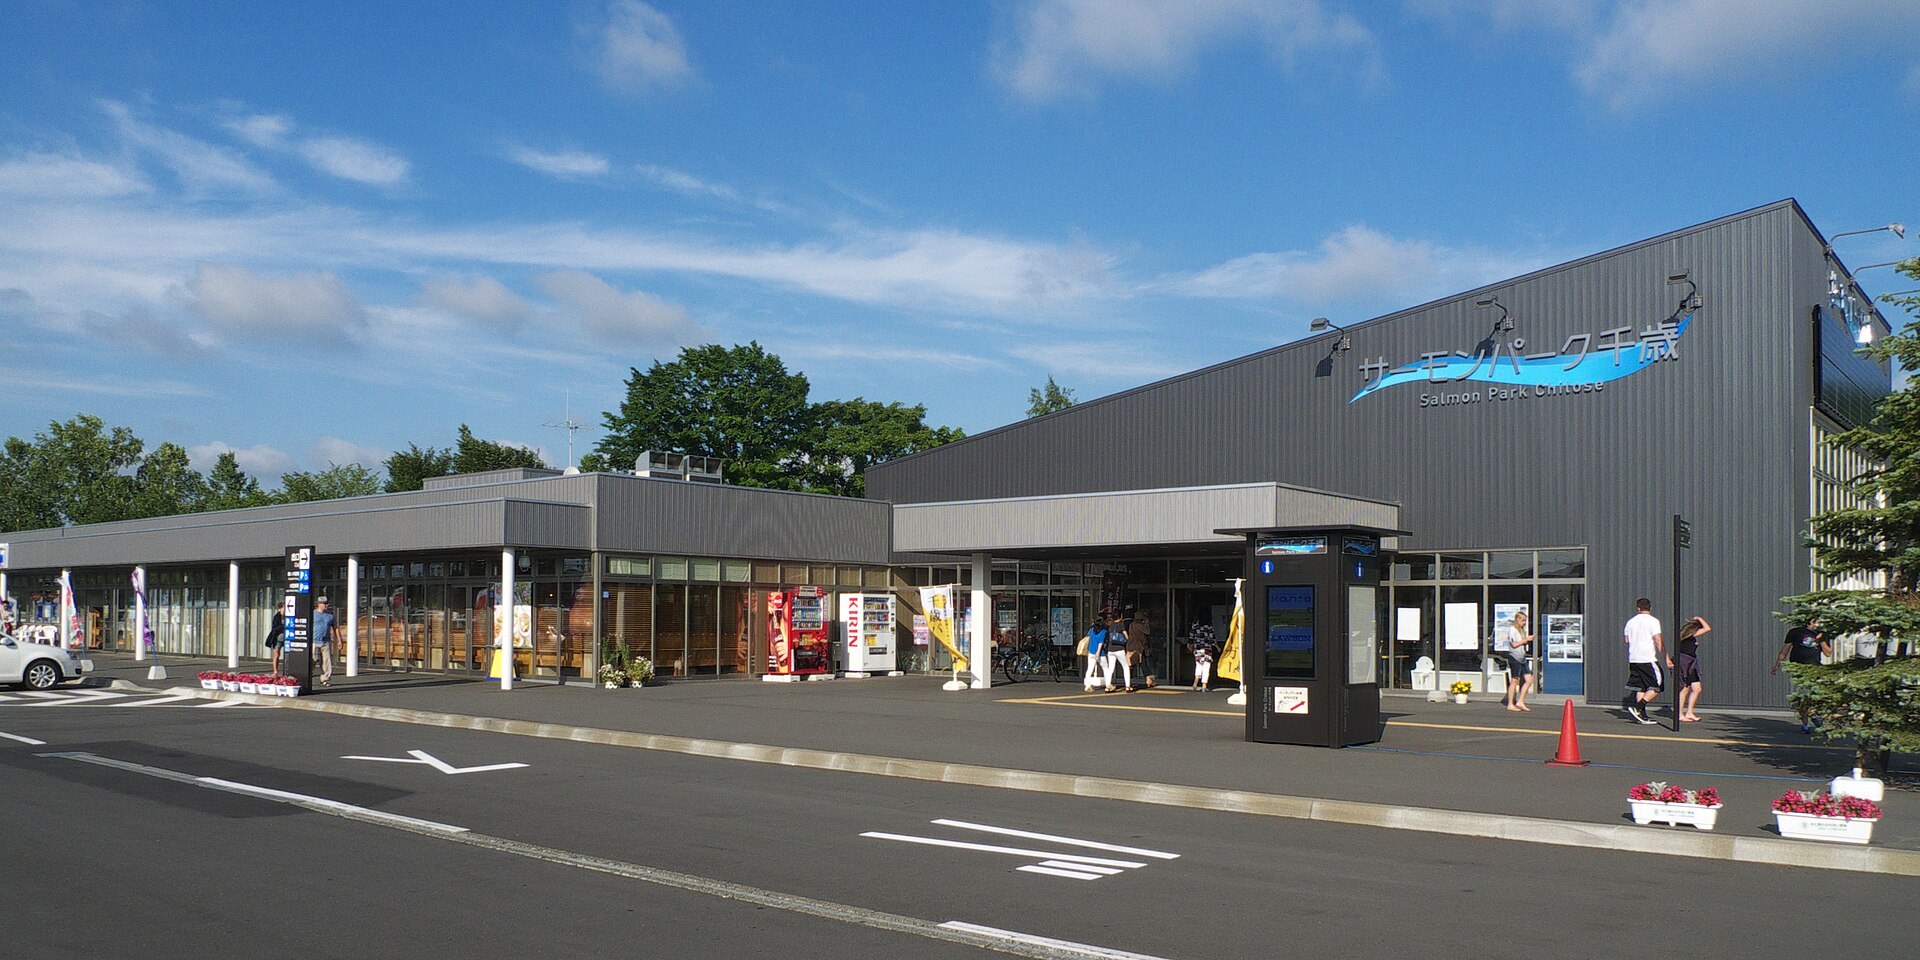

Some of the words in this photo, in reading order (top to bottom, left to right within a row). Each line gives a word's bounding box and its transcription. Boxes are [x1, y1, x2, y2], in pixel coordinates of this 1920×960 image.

[1358, 322, 1680, 392] サーモンパーク千歳
[1420, 390, 1481, 408] Salmon
[1488, 385, 1528, 402] Park
[1535, 378, 1605, 398] Chitose
[849, 597, 858, 647] KIRIN
